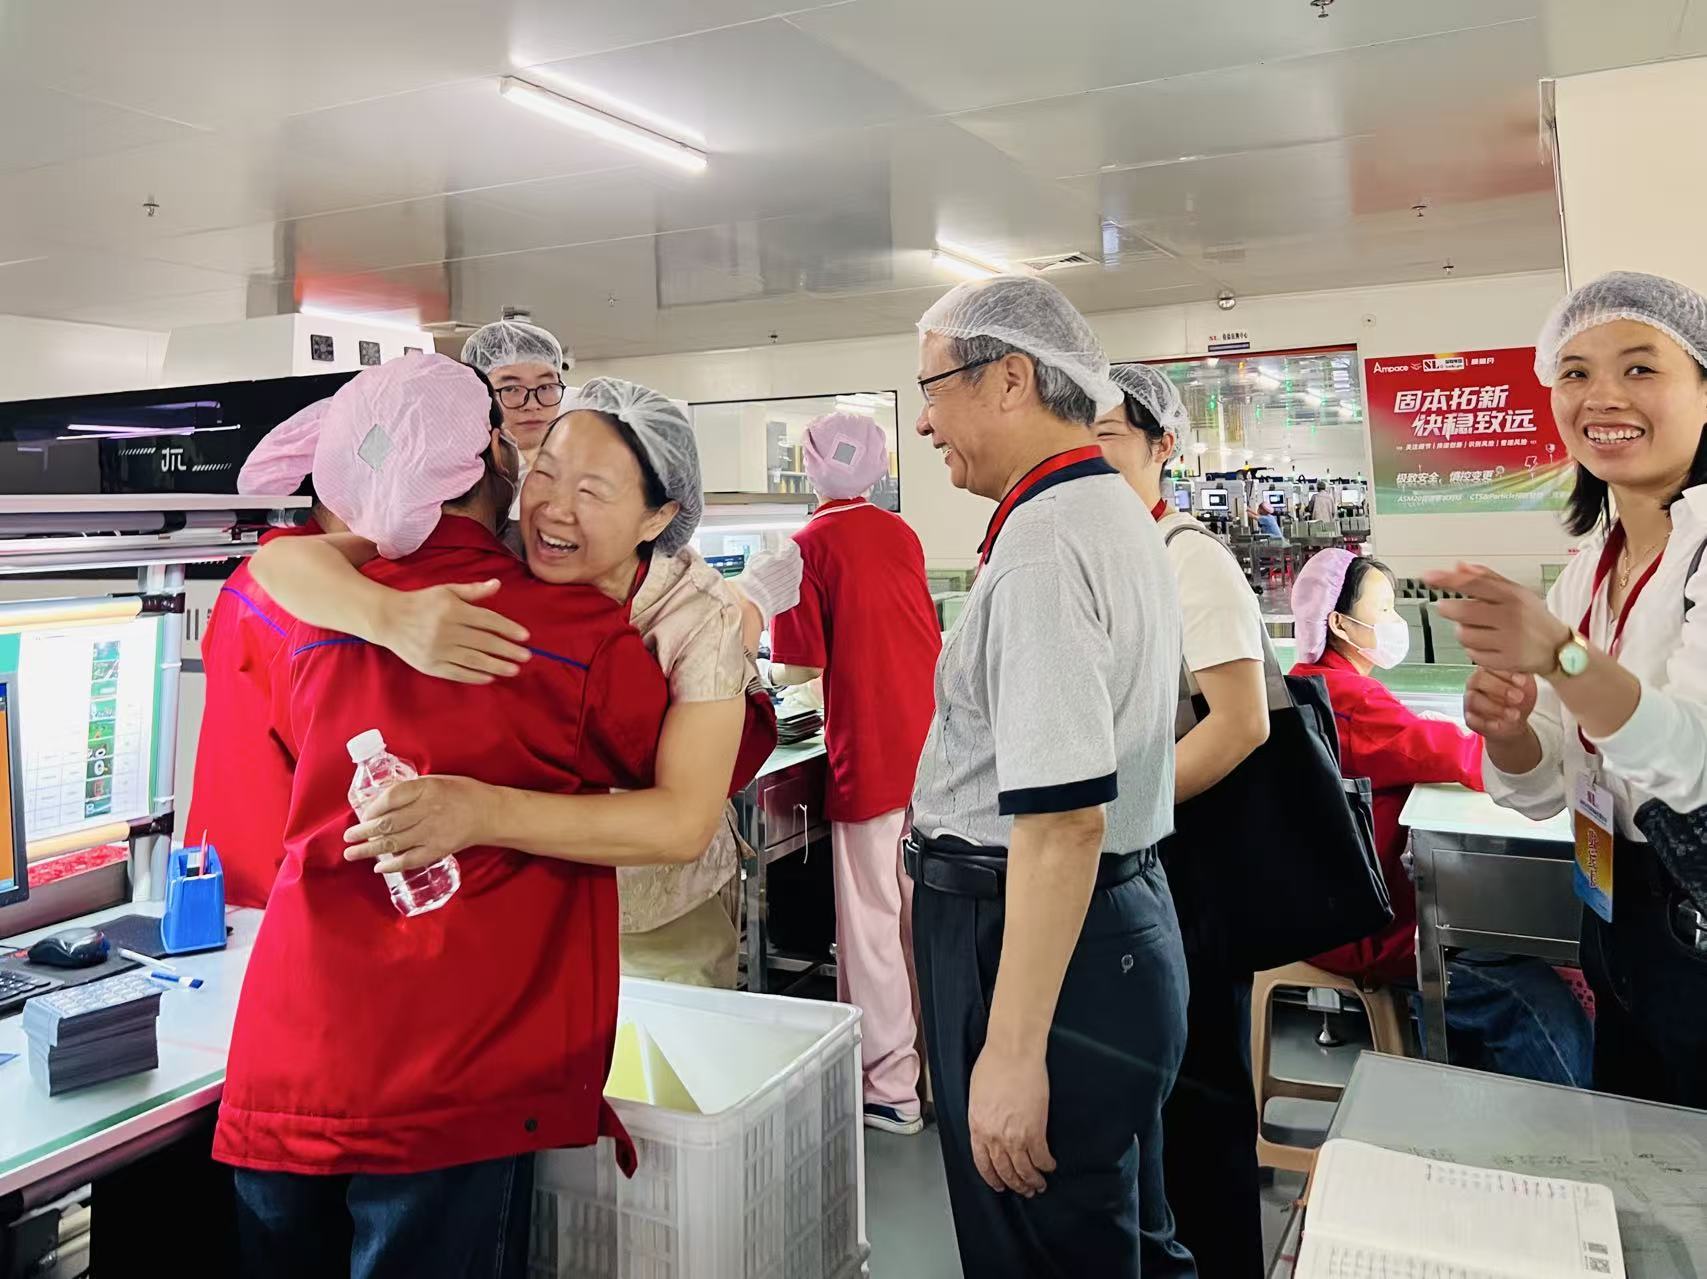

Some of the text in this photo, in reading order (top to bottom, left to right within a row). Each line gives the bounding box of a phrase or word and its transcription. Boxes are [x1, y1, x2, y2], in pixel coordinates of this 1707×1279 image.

[1373, 362, 1409, 373] Ampace
[1394, 385, 1509, 413] 固本拓新
[1411, 409, 1537, 441] 快稳致远
